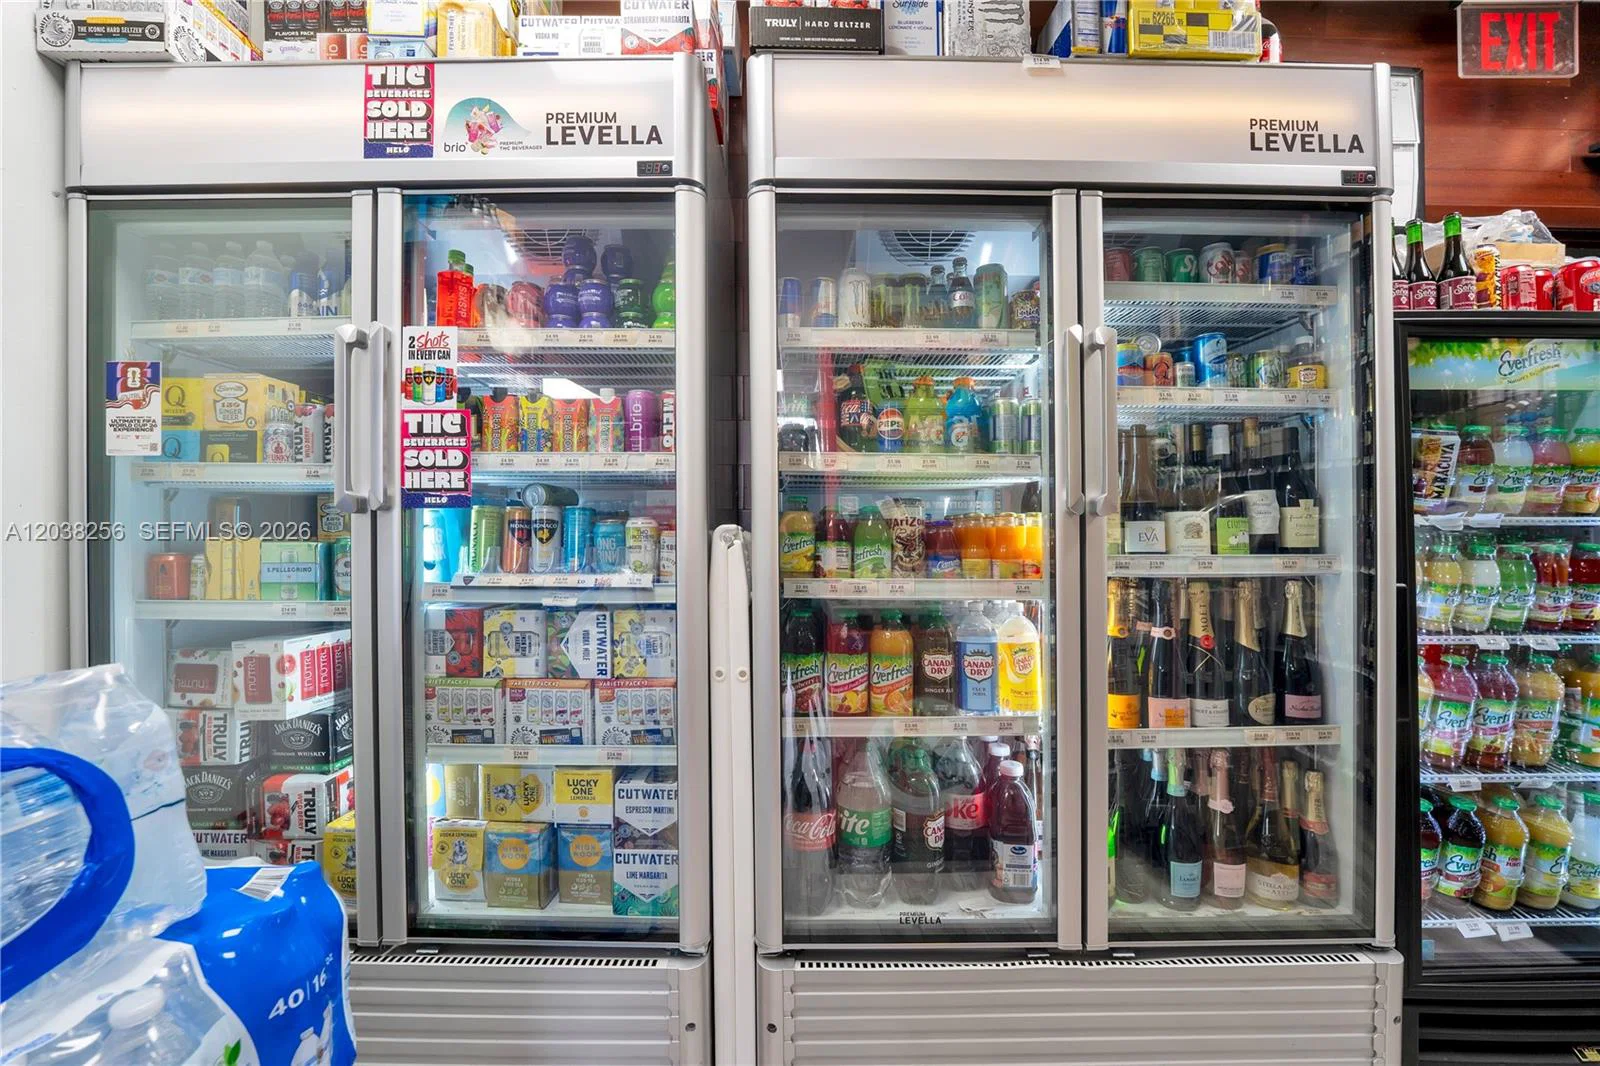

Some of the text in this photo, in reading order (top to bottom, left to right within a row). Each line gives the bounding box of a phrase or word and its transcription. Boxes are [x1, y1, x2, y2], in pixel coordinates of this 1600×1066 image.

[624, 0, 690, 10] CUTWATER
[765, 18, 797, 28] TRULY
[834, 21, 871, 29] SELTZER
[1480, 11, 1560, 72] EXIT
[366, 64, 428, 87] THC
[366, 89, 431, 98] BEVERAGES
[366, 100, 427, 120] SOLD
[546, 112, 617, 124] PREMIUM
[366, 121, 427, 141] HERE
[1250, 118, 1319, 131] PREMIUM
[546, 125, 663, 145] LEVELLA
[1250, 132, 1364, 153] LEVELLA
[443, 142, 466, 153] brio
[408, 336, 416, 348] 2
[408, 350, 451, 360] IN EVERY CAN
[1498, 344, 1561, 377] Everfresh
[404, 413, 463, 434] THC
[630, 403, 643, 431] brio
[294, 420, 303, 463] TRULY
[323, 422, 331, 463] TRULY
[404, 438, 467, 447] BEVERAGES
[404, 450, 464, 468] SOLD
[1432, 443, 1456, 499] MARACUYA
[404, 471, 466, 489] HERE
[1138, 528, 1159, 542] EVA
[596, 614, 608, 677] CUTWATER
[930, 666, 948, 675] DRY
[970, 668, 988, 676] DRY
[274, 719, 322, 736] JACK DANIEL'S
[212, 714, 227, 761] TRULY
[186, 772, 232, 790] ACK DANIEL'S
[567, 779, 598, 787] LUCKY
[572, 788, 593, 796] ONE
[304, 788, 316, 835] TRULY
[626, 806, 652, 814] ESPRESSO
[193, 832, 248, 844] UTWATER
[615, 854, 678, 865] CUTWATER
[639, 872, 668, 880] MARGARITA
[312, 967, 328, 993] 16
[268, 988, 305, 1020] 40
